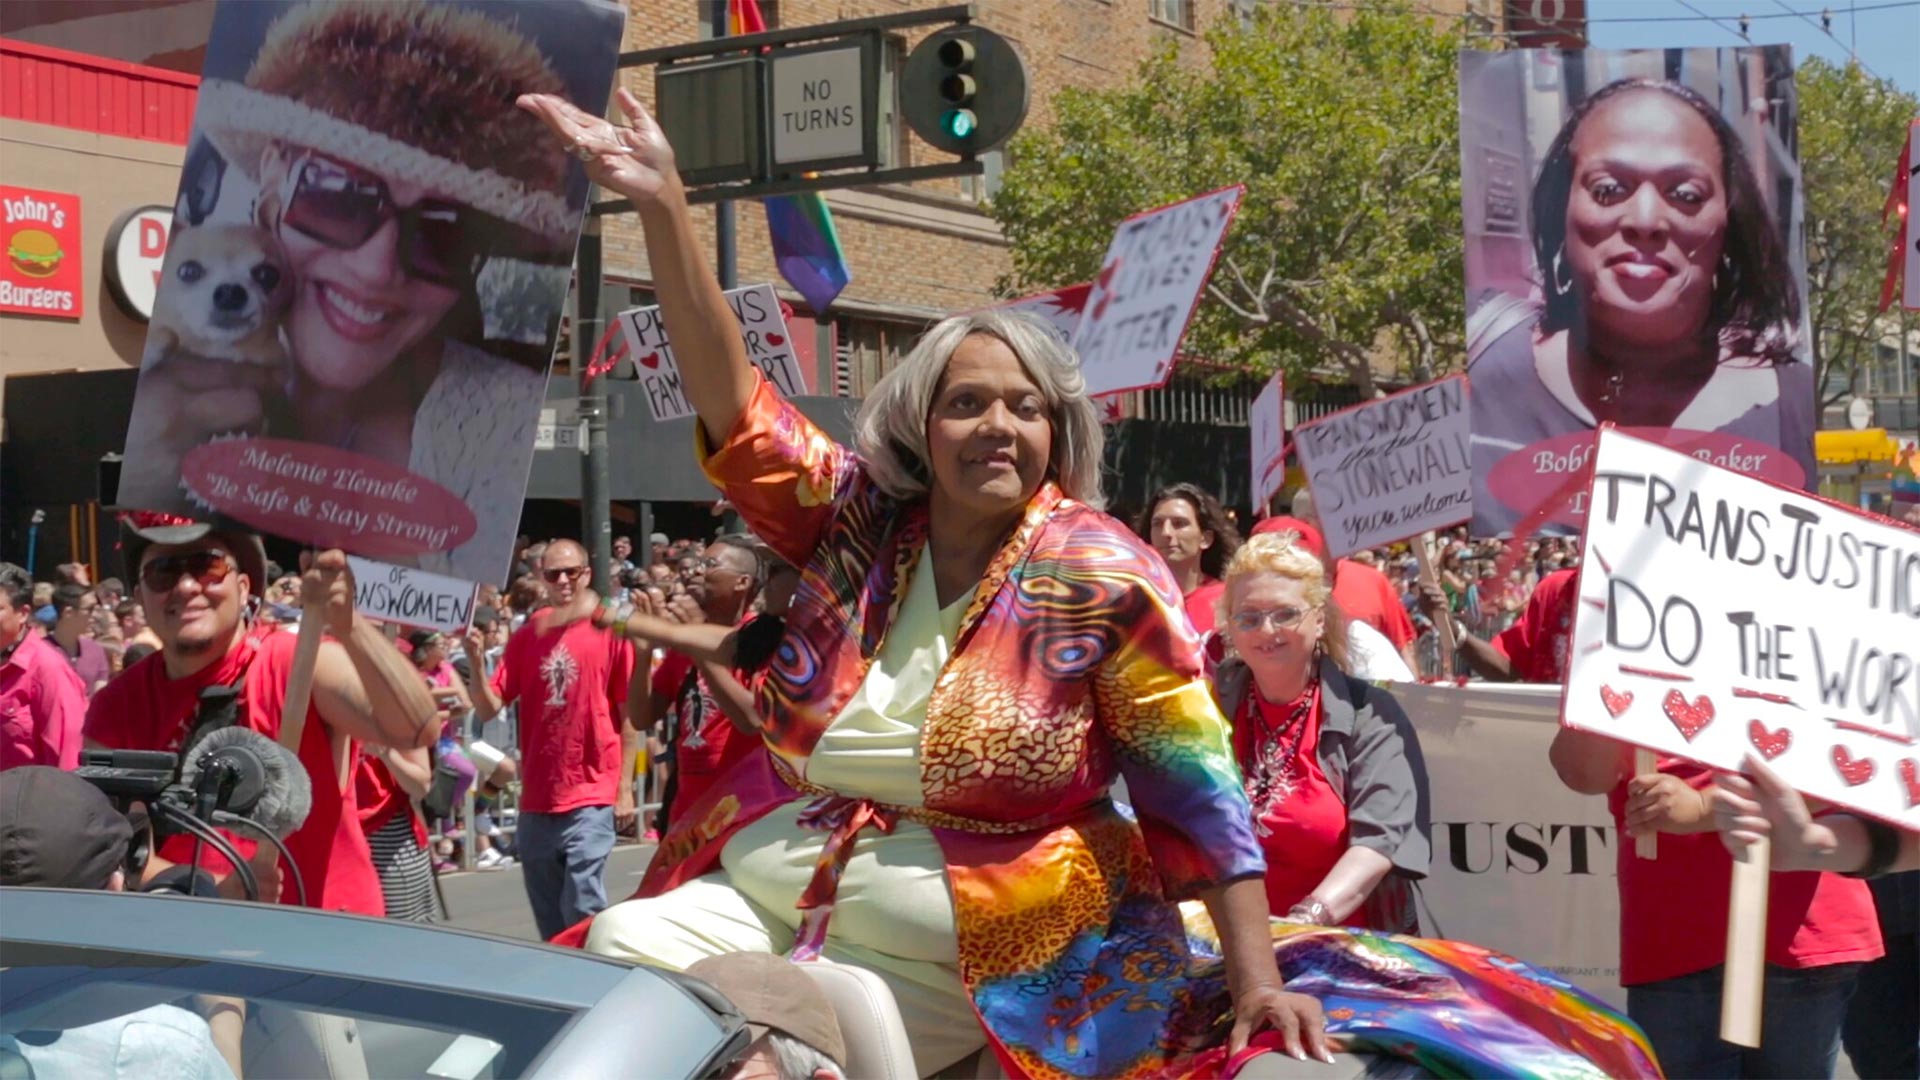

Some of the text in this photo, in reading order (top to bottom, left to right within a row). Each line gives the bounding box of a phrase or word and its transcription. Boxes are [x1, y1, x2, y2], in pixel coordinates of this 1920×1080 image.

[803, 79, 832, 102] NO
[782, 105, 854, 133] TURNS
[4, 195, 66, 229] John's
[0, 279, 73, 311] Burgers
[240, 447, 328, 484] Melenie
[1313, 432, 1472, 513] STONEWALL
[246, 482, 289, 513] Safe
[294, 496, 311, 518] &
[316, 500, 369, 532] Stay
[1400, 489, 1473, 521] welcome
[1595, 469, 1771, 566] TRANS
[389, 566, 409, 585] OF
[1605, 576, 1920, 738] DO THE WOR
